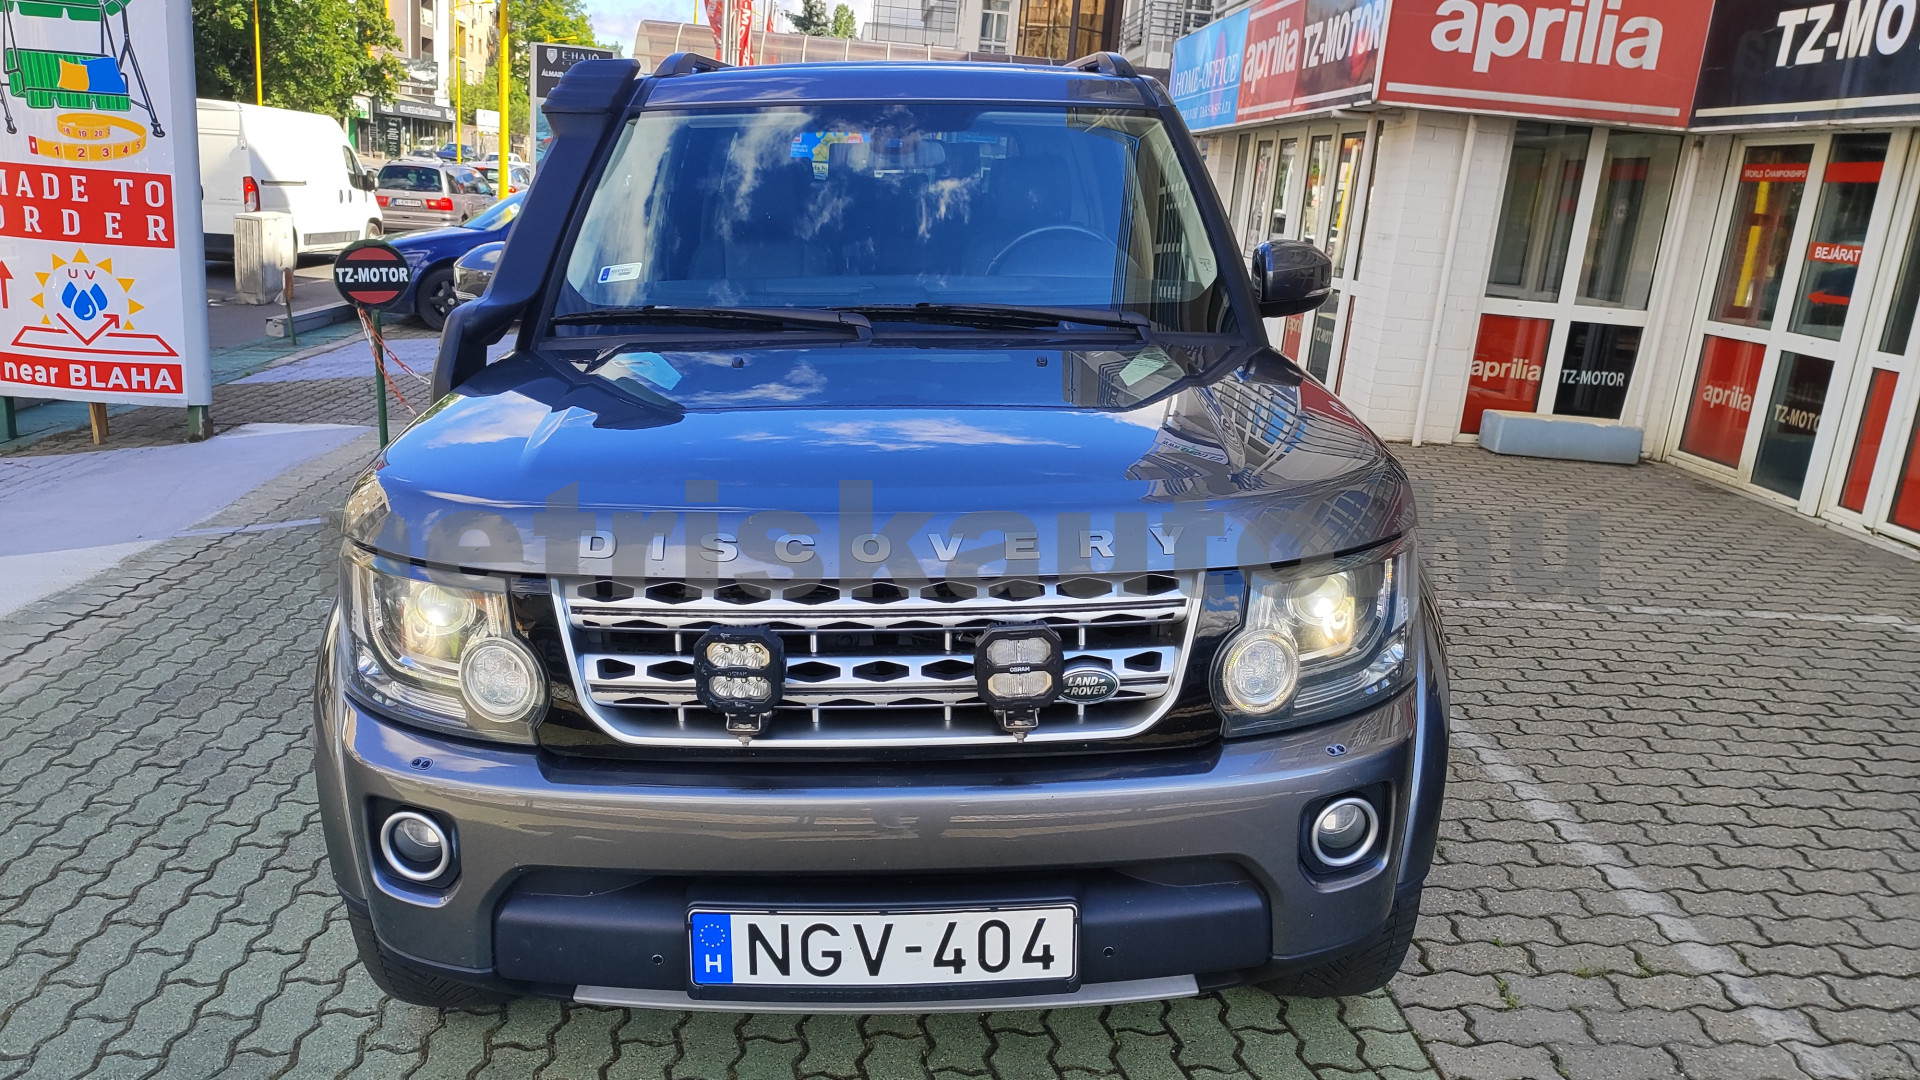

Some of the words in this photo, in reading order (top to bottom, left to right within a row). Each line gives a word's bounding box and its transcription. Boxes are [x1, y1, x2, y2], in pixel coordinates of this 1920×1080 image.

[1302, 1, 1387, 71] TZ-MOTOR
[1430, 0, 1664, 73] aprilia
[1775, 0, 1920, 68] TZ-MO
[1243, 18, 1300, 94] aprilia
[1174, 53, 1239, 97] HOME-OFFICE
[63, 127, 70, 135] 18
[53, 146, 60, 156] 1
[77, 148, 86, 158] 2
[102, 148, 110, 158] 3
[122, 145, 129, 155] 4
[136, 141, 141, 149] 5
[114, 178, 165, 208] TO
[0, 204, 168, 242] RDER
[1815, 245, 1862, 262] BEJÁRAT
[336, 267, 409, 283] TZ-MOTOR
[4, 361, 59, 384] near
[69, 364, 176, 390] BLAHA
[1471, 358, 1542, 382] aprilia
[1562, 369, 1625, 387] TZ-MOTOR
[1703, 385, 1753, 412] aprilia
[578, 525, 1185, 563] DISCOVERY
[1068, 676, 1098, 687] LAND
[1071, 686, 1108, 696] ROVER
[747, 917, 1055, 977] NGV-404
[705, 953, 723, 974] H
